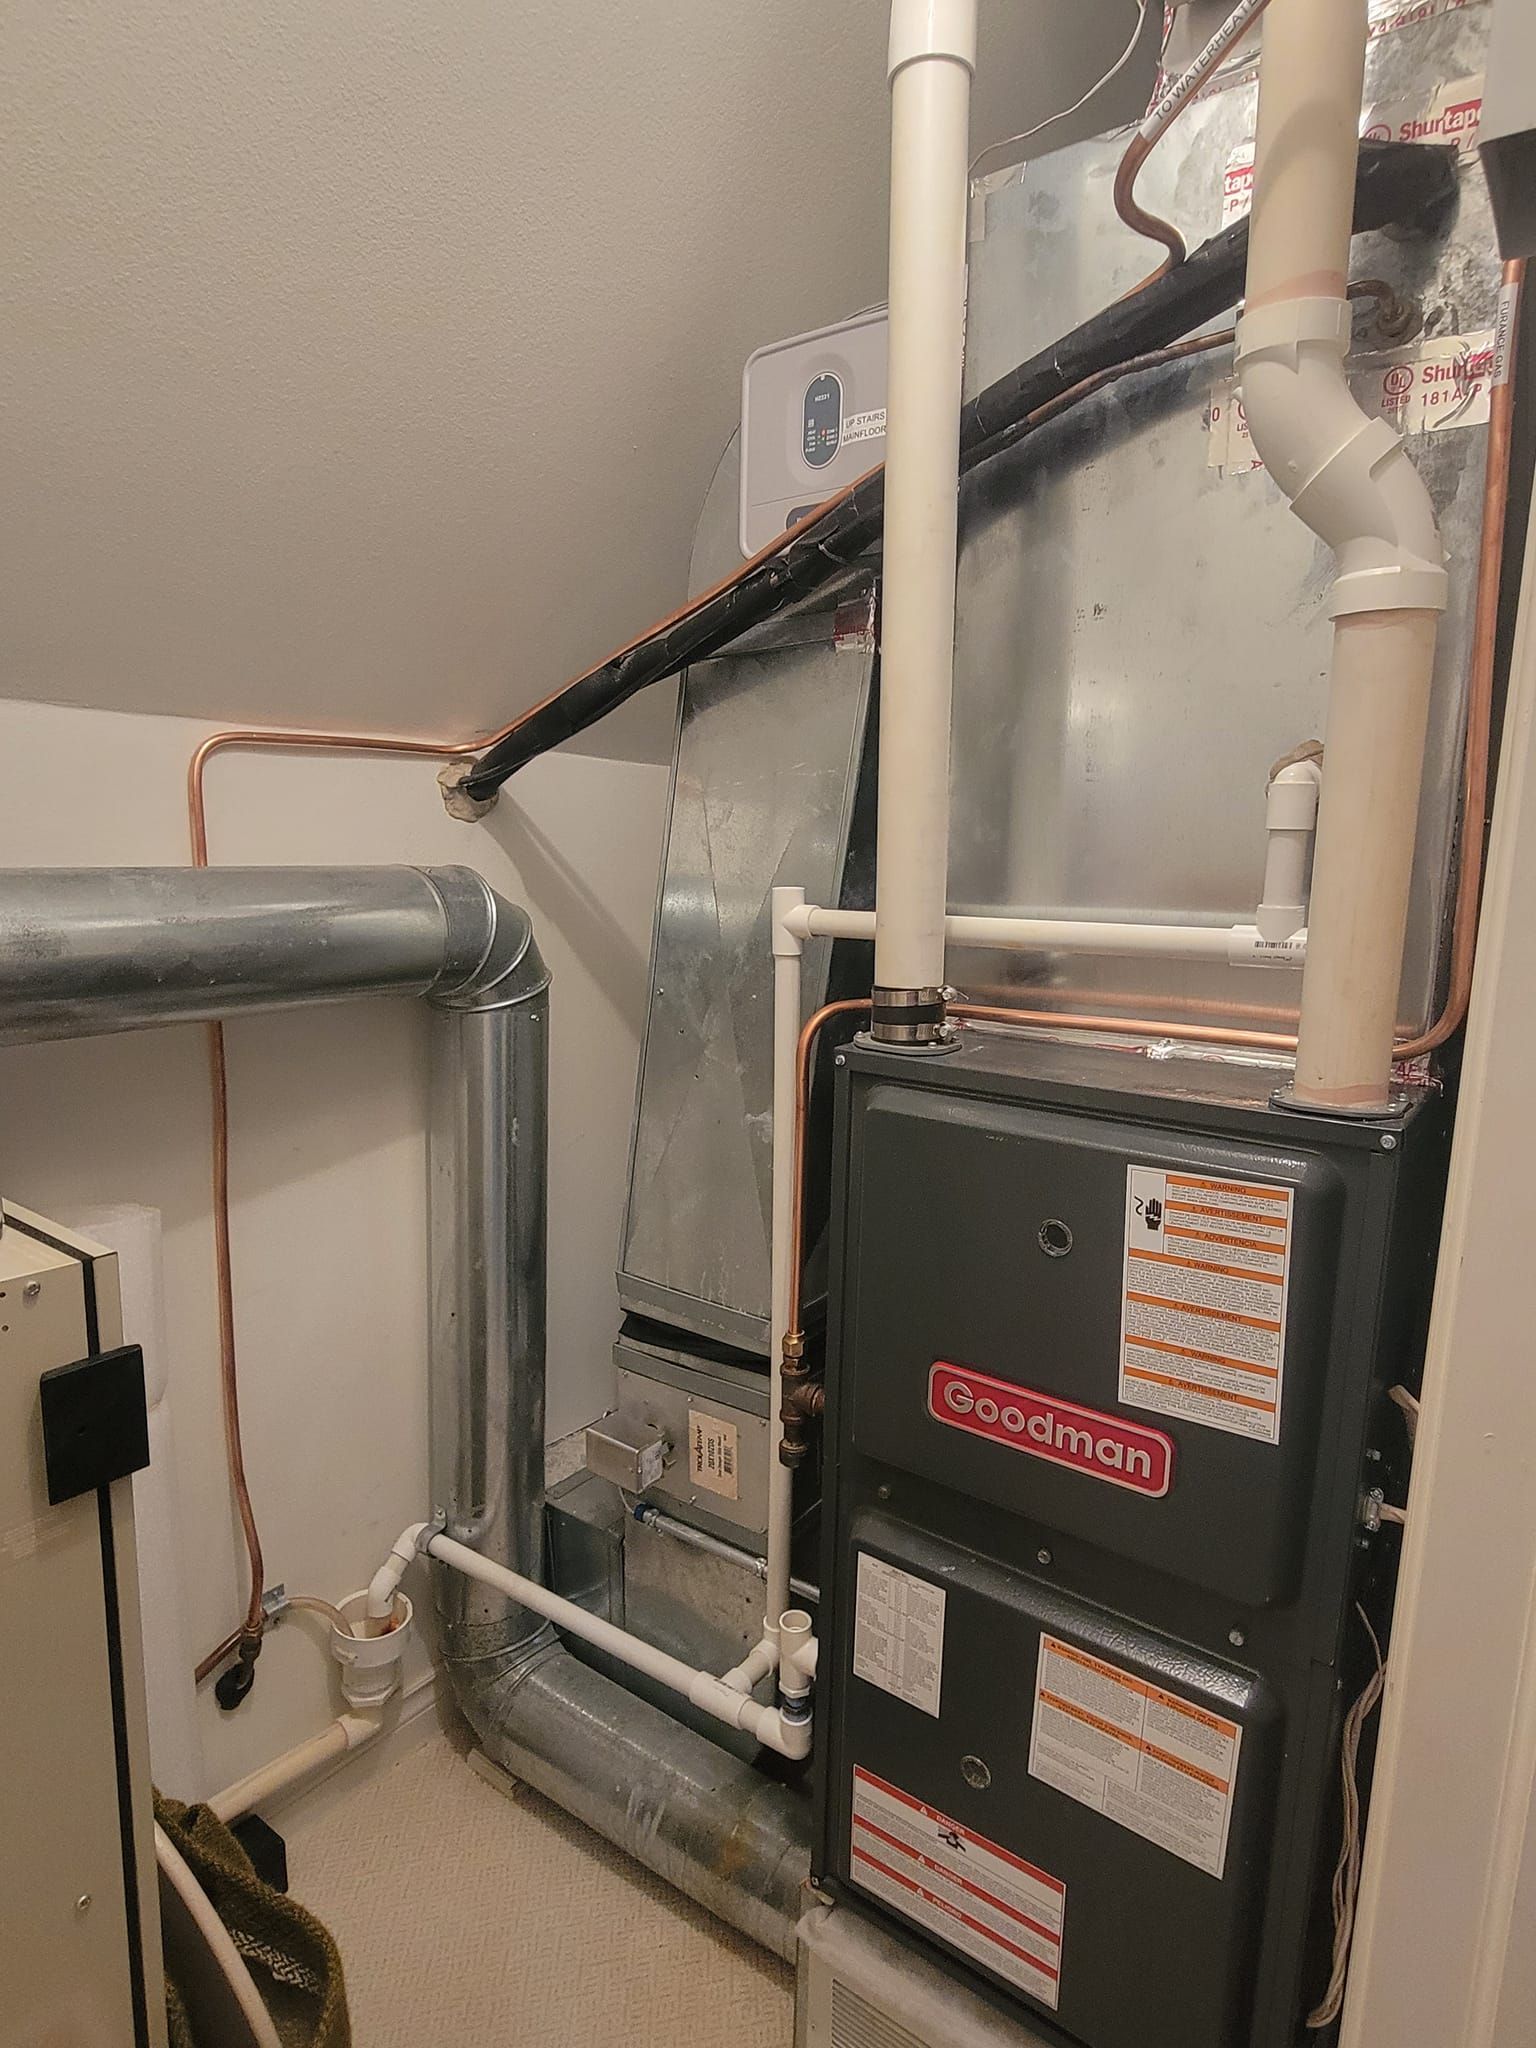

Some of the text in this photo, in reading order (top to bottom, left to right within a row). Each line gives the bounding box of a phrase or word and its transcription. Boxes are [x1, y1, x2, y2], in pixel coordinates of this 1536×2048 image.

[1154, 100, 1172, 120] TO
[1399, 102, 1482, 140] Shurtap
[845, 411, 885, 429] UP STAIRS
[1209, 1182, 1247, 1194] WARNING
[1200, 1207, 1264, 1223] AVERTISSEMENT
[1203, 1233, 1258, 1248] ADVERTENCIA
[1193, 1262, 1229, 1275] WARNING
[1181, 1304, 1241, 1322] AVERTISSEMENT
[1190, 1351, 1226, 1364] WARNING
[1178, 1381, 1238, 1401] AVERTISSEMENT
[943, 1380, 1151, 1480] Goodman
[936, 1814, 965, 1836] DANGER
[934, 1863, 963, 1886] DANGER
[932, 1896, 962, 1920] PELIGRO
